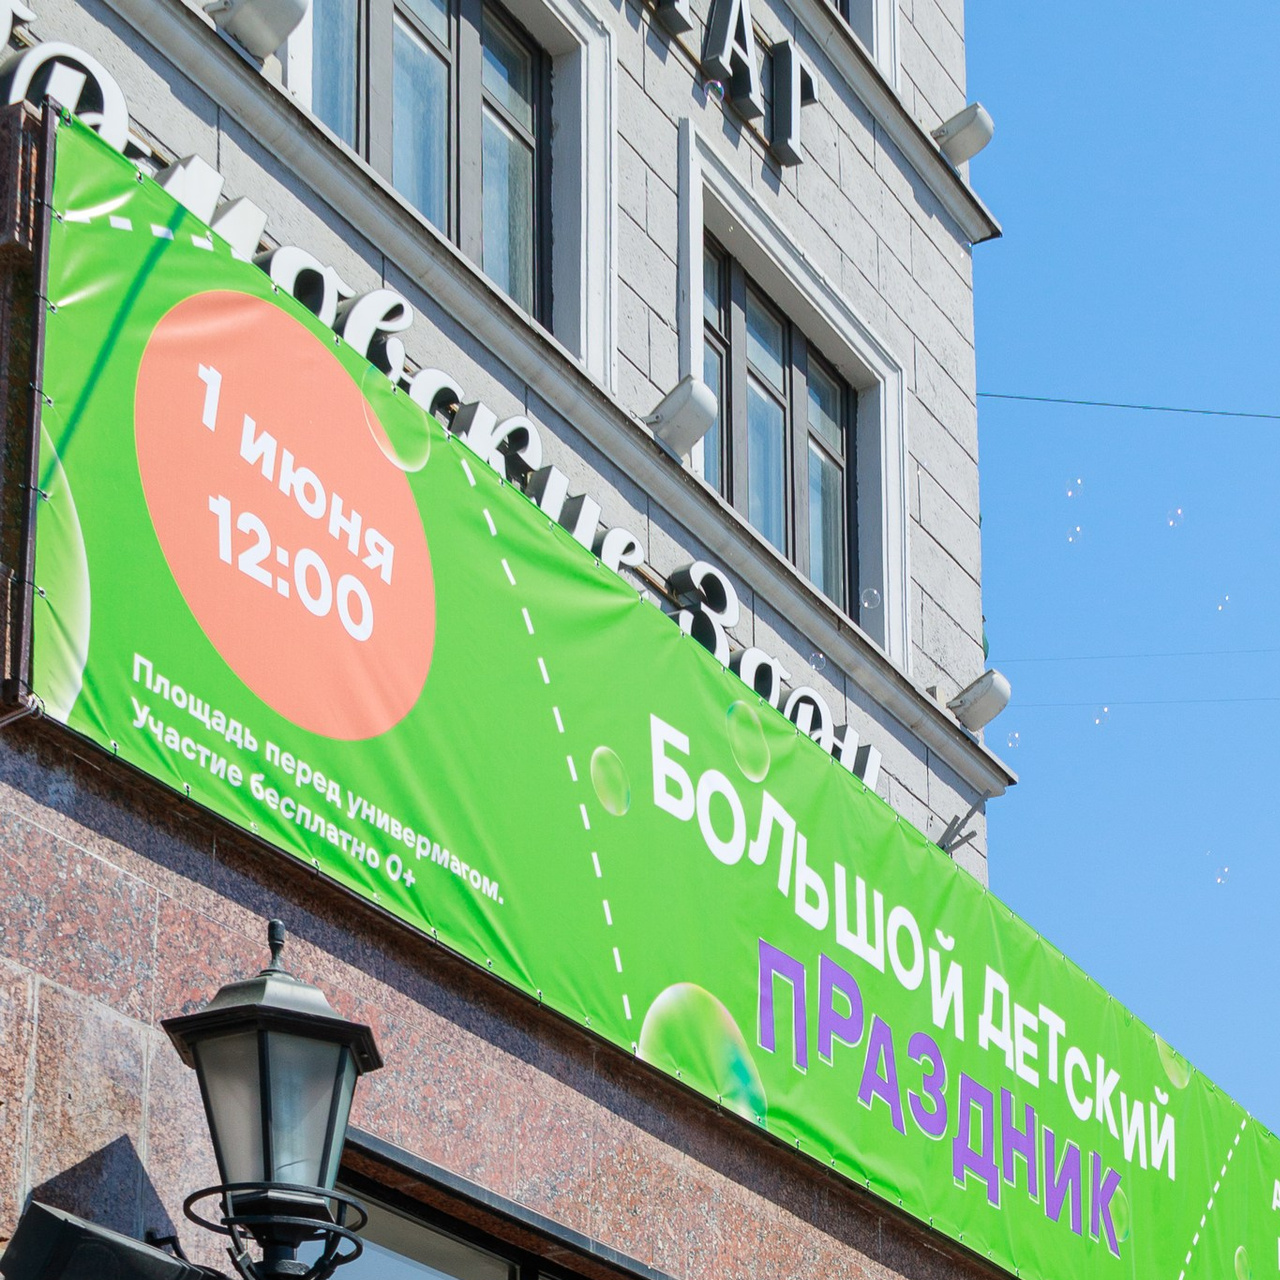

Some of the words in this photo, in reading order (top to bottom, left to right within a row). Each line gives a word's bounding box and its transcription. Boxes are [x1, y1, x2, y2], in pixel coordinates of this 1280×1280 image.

[198, 363, 222, 432] 1
[240, 413, 395, 586] июня
[208, 494, 374, 642] 12:00
[131, 695, 243, 787] Участие
[249, 772, 381, 869] бесплатно
[385, 854, 416, 888] 0+
[132, 652, 259, 753] Площадь
[265, 740, 342, 803] перед
[346, 789, 505, 906] универмагом.
[650, 712, 965, 1042] БОЛЬШОЙ
[978, 963, 1175, 1182] ДЕТСКИЙ
[757, 936, 1122, 1260] ПРАЗДНИК
